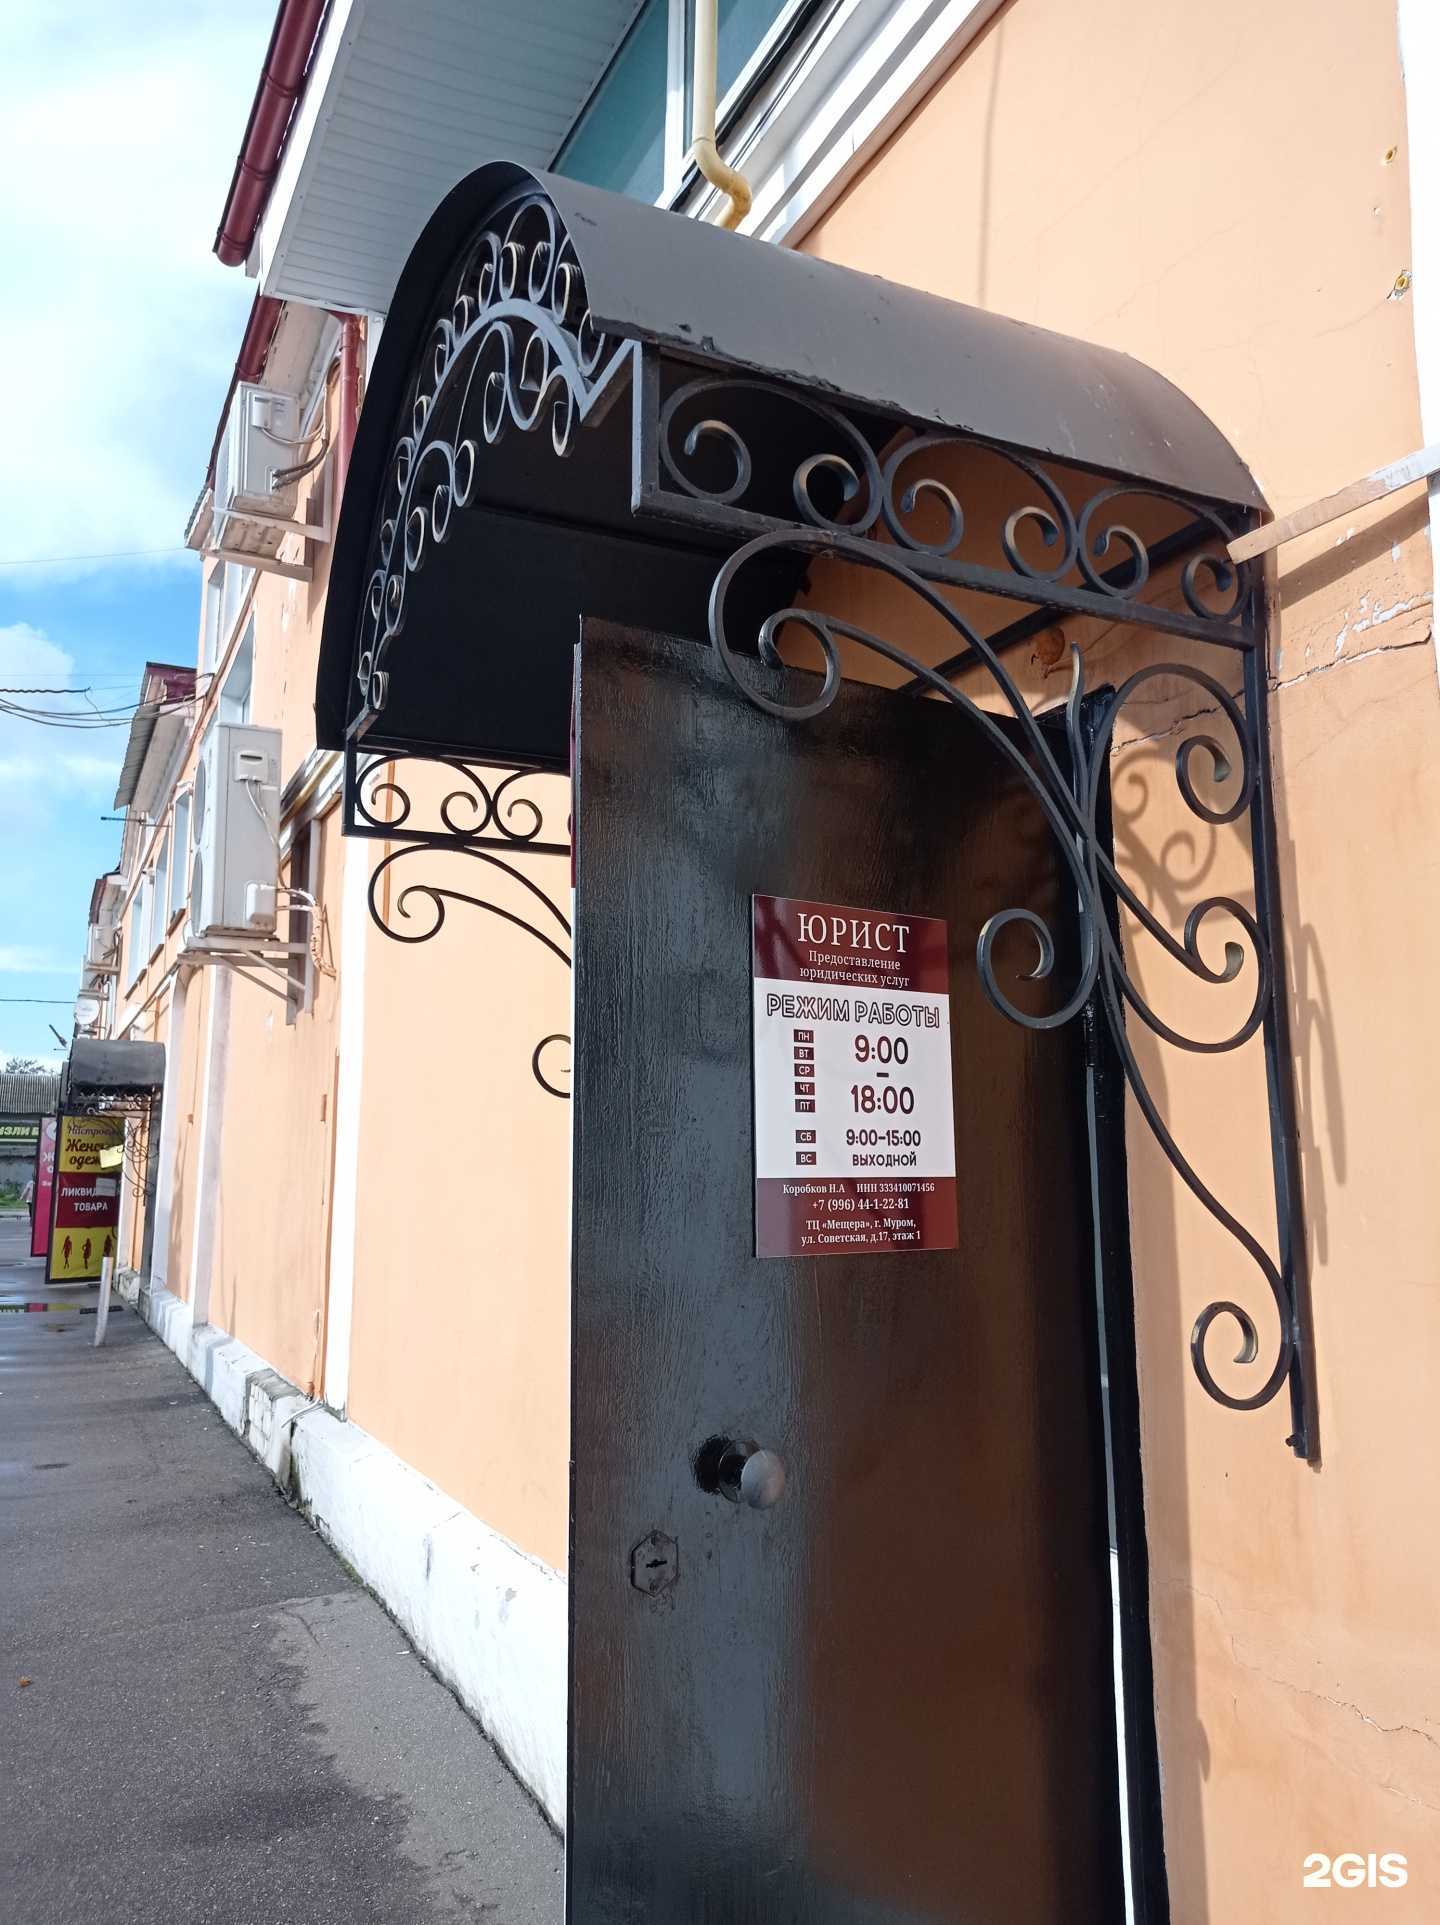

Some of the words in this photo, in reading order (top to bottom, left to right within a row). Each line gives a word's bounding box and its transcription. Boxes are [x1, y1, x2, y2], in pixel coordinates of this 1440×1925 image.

[797, 912, 910, 953] ЮРИСТ
[808, 950, 901, 970] Предоставление
[799, 966, 879, 985] юридических
[880, 975, 911, 989] услуг
[766, 993, 850, 1022] РЕЖИМ
[855, 1000, 940, 1029] РАБОТЫ
[798, 1031, 810, 1041] ПН
[798, 1049, 810, 1058] ВТ
[854, 1034, 909, 1065] 9:00
[798, 1066, 810, 1075] СР
[799, 1084, 810, 1093] ЧТ
[799, 1101, 811, 1111] ПТ
[850, 1084, 915, 1115] 18:00
[800, 1132, 812, 1142] СБ
[846, 1128, 921, 1147] 9:00-15:00
[800, 1154, 812, 1163] ВС
[852, 1151, 917, 1167] ВЫХОДНОЙ
[783, 1183, 827, 1197] Коробков
[828, 1183, 846, 1193] Н.А
[856, 1183, 878, 1193] ИНН
[879, 1182, 935, 1193] 333410071456
[74, 1202, 108, 1212] ТОВАРА
[812, 1199, 825, 1211] +7
[827, 1198, 855, 1212] (996)
[857, 1198, 909, 1210] 44-1-22-81
[805, 1219, 821, 1231] ТЦ
[822, 1219, 873, 1231] «Мещера»,
[874, 1219, 881, 1228] г.
[882, 1217, 916, 1230] Муром,
[801, 1235, 816, 1247] ул.
[817, 1233, 869, 1243] Советская,
[892, 1231, 915, 1241] этаж
[915, 1230, 921, 1240] 1
